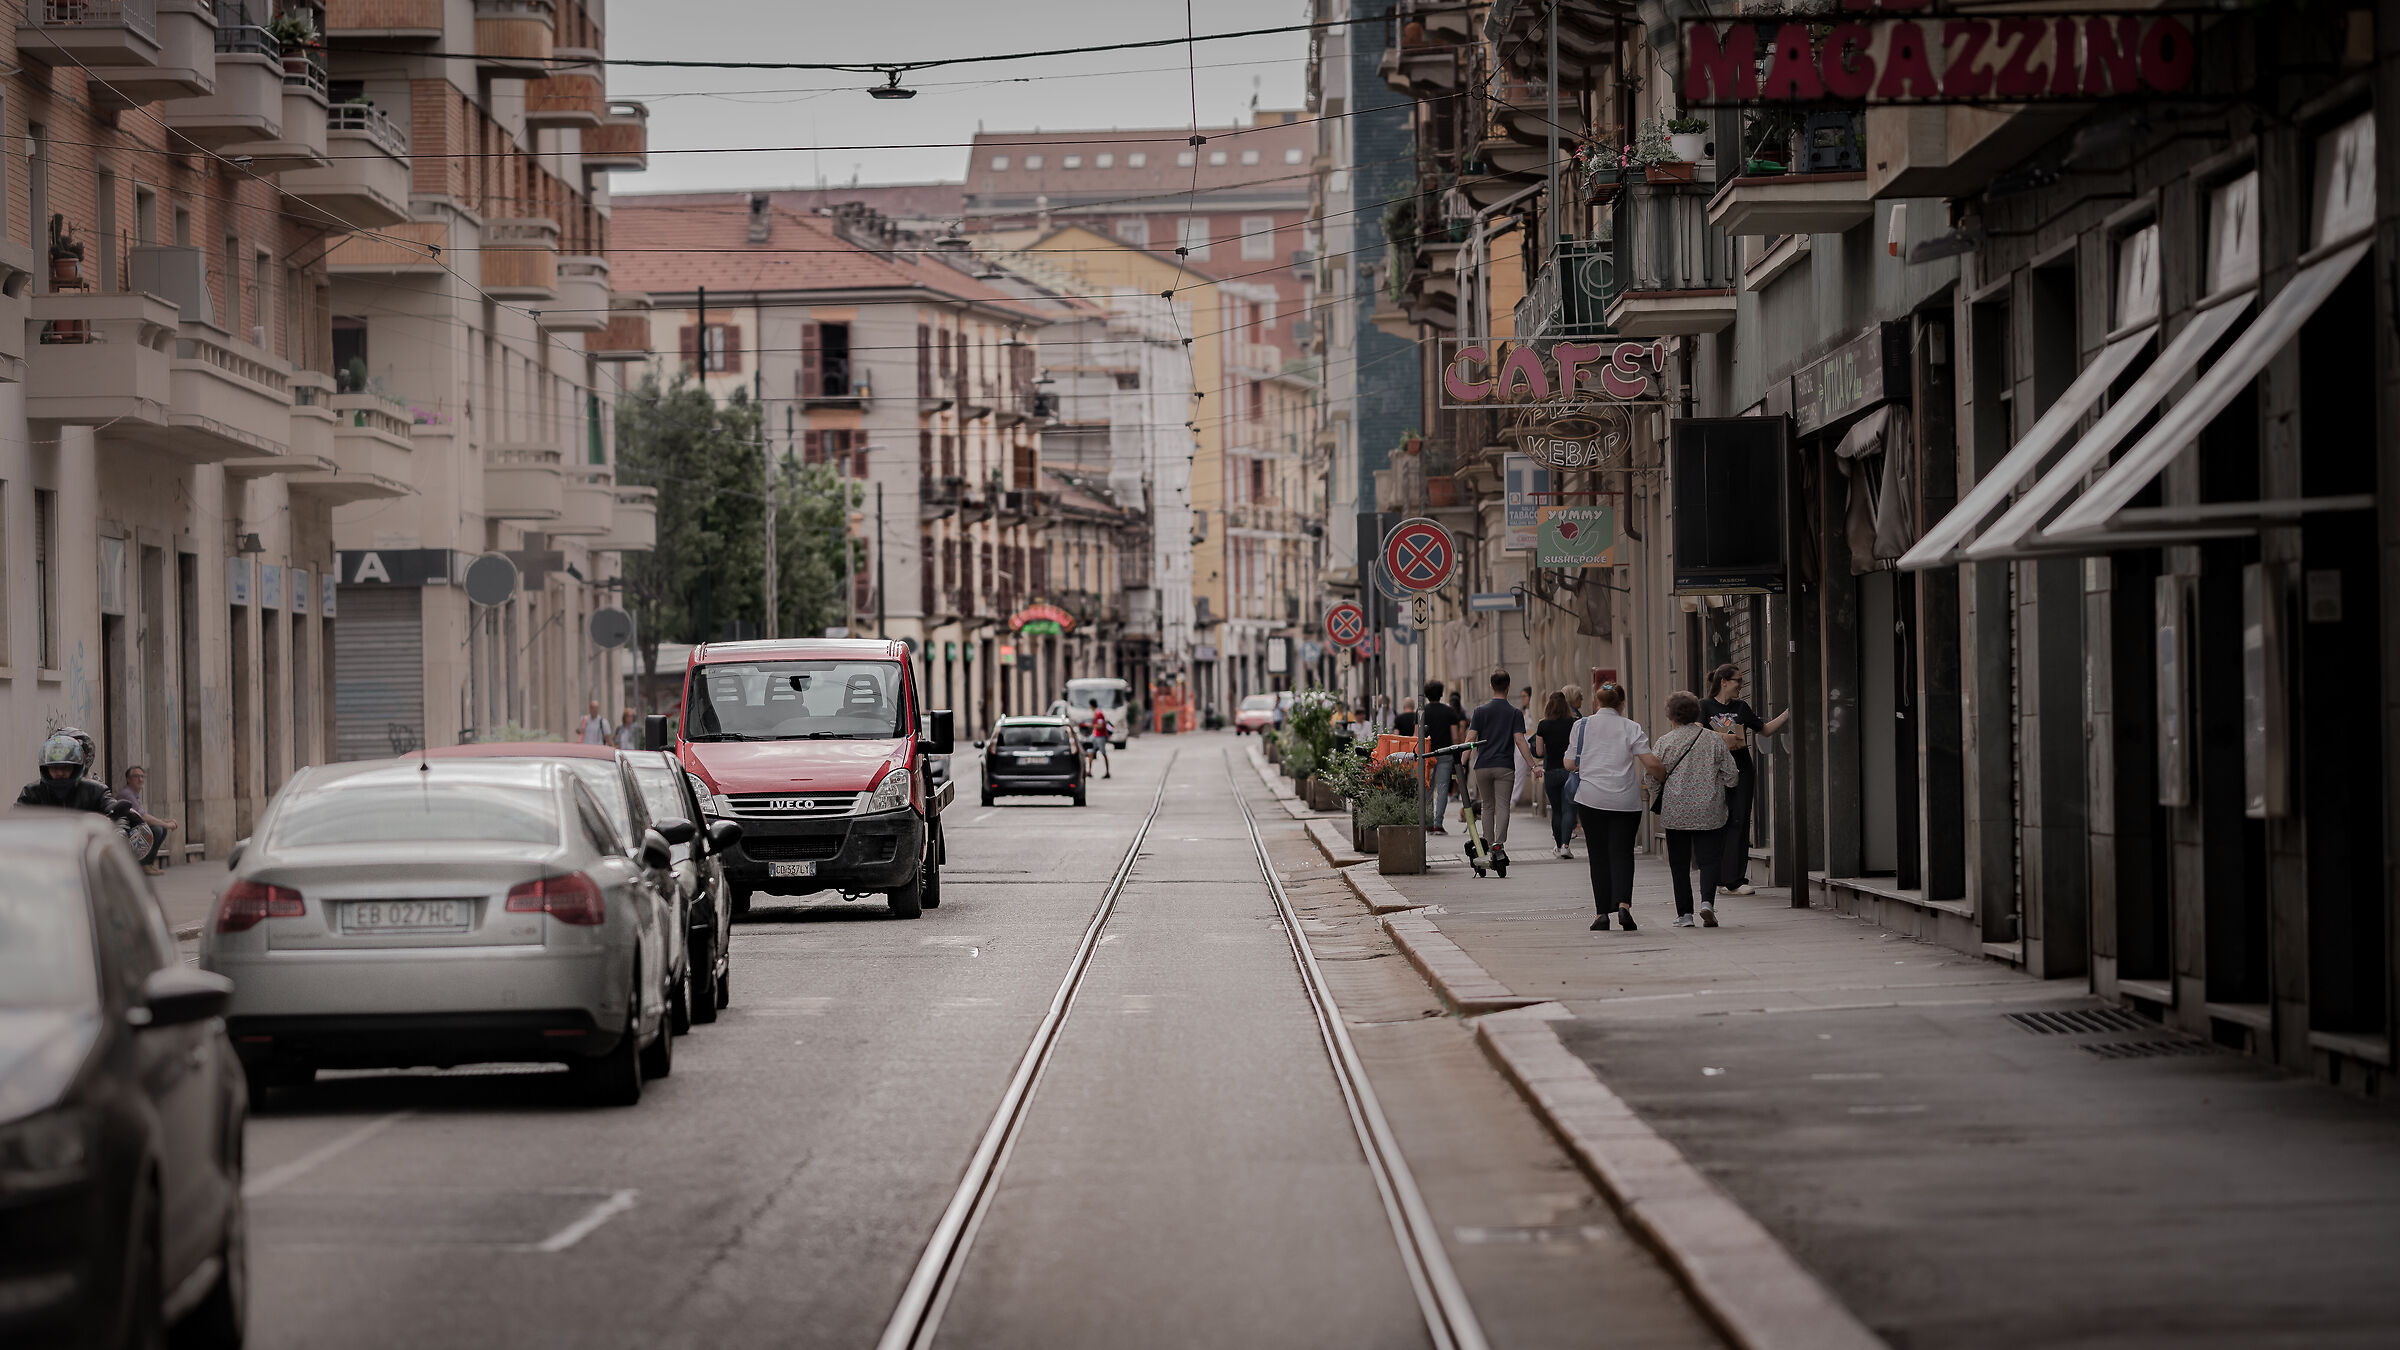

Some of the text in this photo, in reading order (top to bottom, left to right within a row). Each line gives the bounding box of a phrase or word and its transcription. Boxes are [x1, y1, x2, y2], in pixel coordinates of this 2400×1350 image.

[1684, 15, 2196, 101] MAGAZZINO
[1529, 394, 1618, 429] PIZZA
[1526, 431, 1620, 467] KEBAP
[1547, 510, 1603, 521] YUMMY
[769, 799, 815, 809] IVECO
[357, 903, 454, 924] EB 027HC
